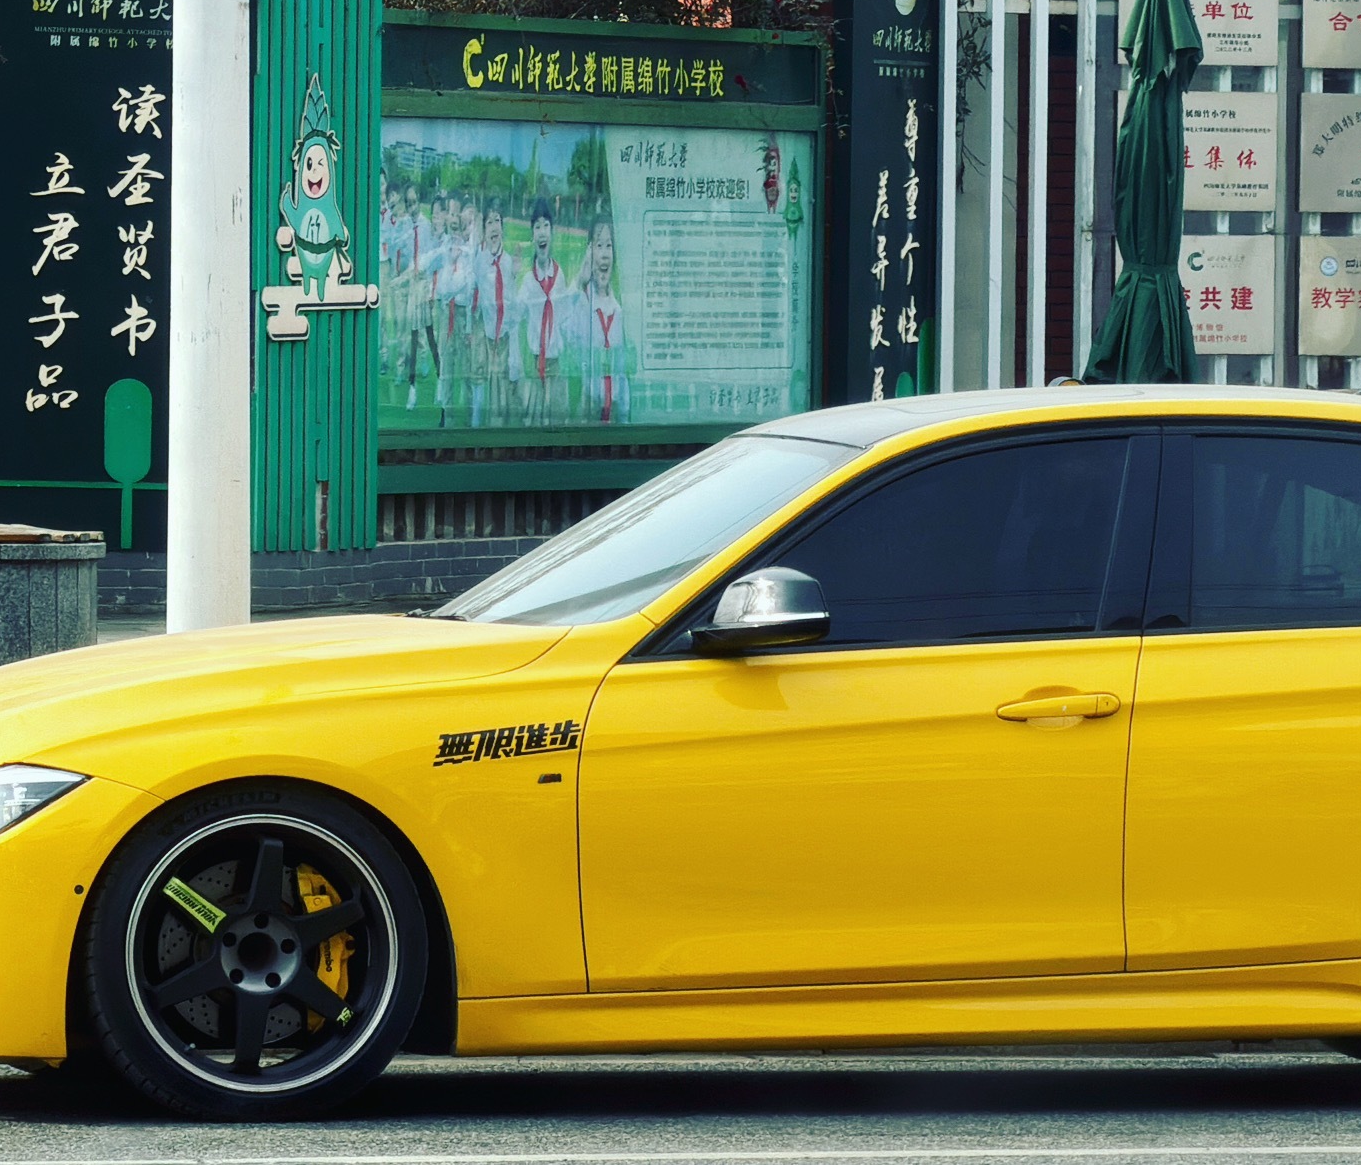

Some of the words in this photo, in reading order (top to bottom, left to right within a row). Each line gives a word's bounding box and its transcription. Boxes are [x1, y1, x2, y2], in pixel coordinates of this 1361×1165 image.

[1191, 0, 1254, 21] 单位
[24, 151, 86, 412] 立君子品
[107, 86, 165, 357] 读圣贤书
[896, 98, 920, 345] 尊重个性
